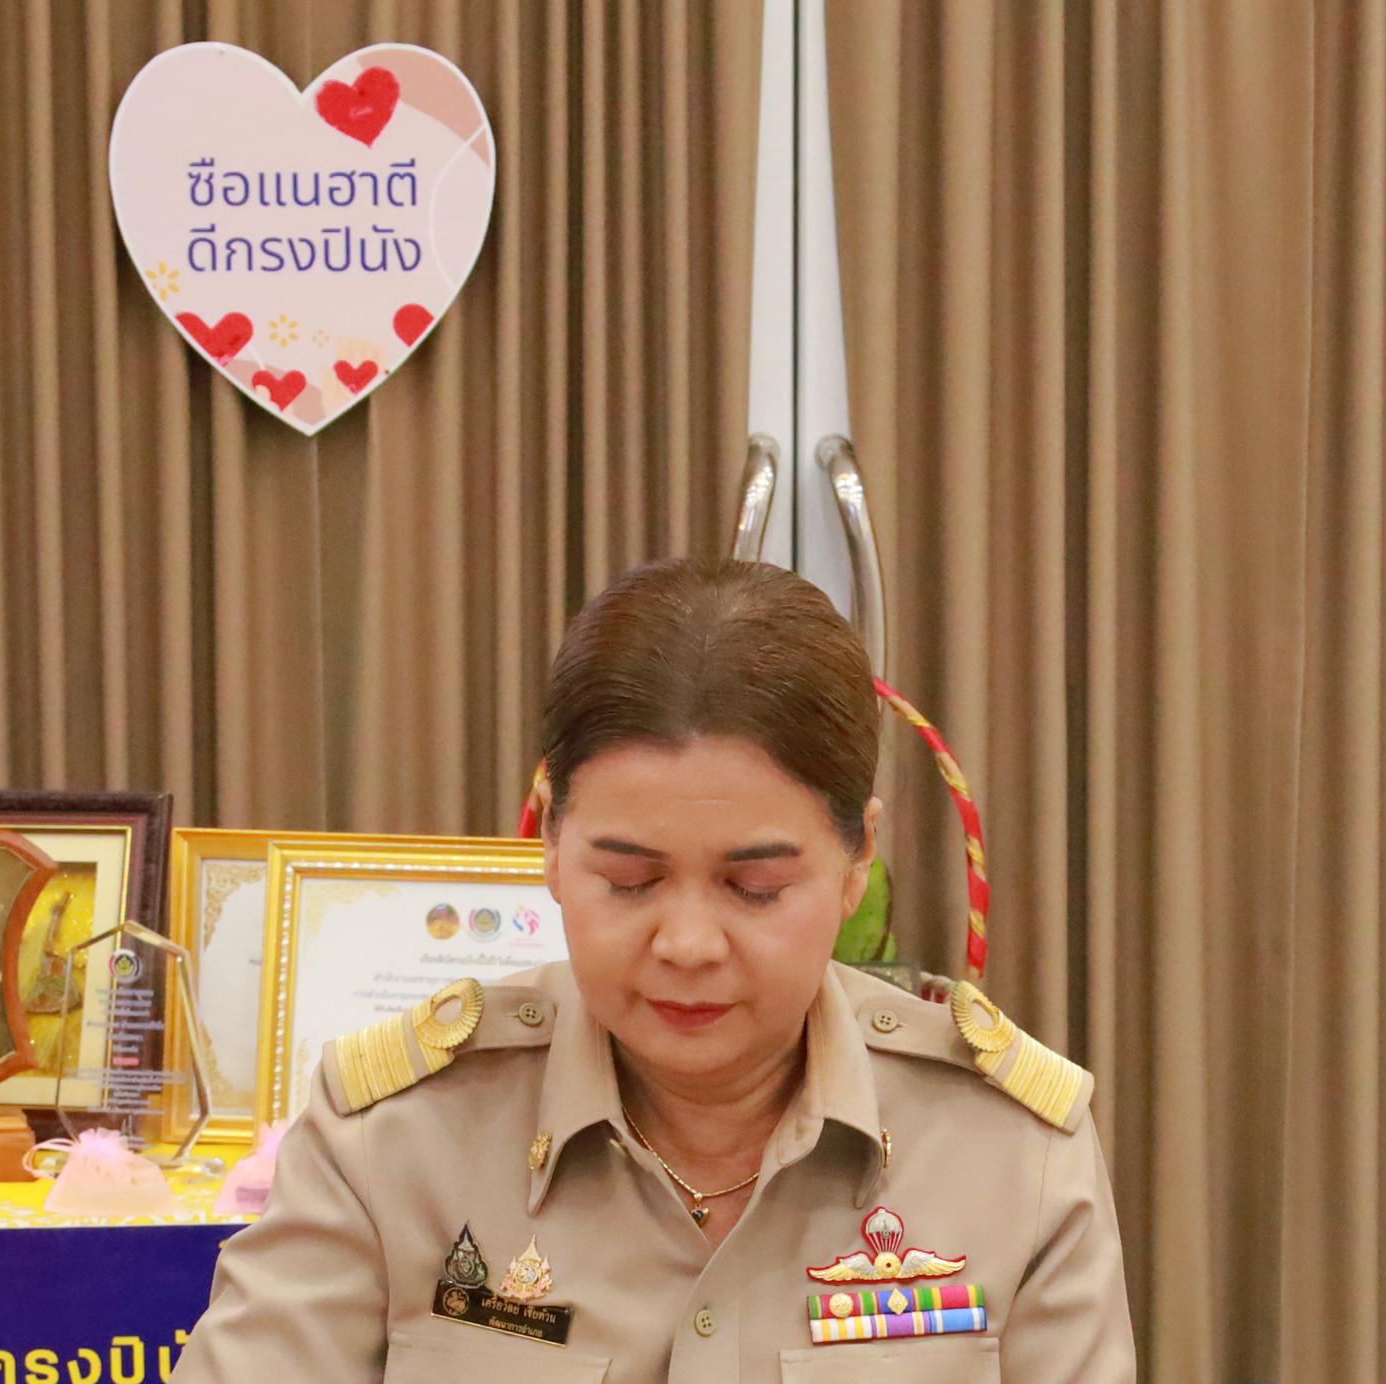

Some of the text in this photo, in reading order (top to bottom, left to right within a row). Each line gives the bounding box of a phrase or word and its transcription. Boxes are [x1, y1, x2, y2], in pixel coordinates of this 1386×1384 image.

[187, 158, 418, 207] ซือแนฮาตี
[187, 224, 422, 272] ดีกรงปินัง
